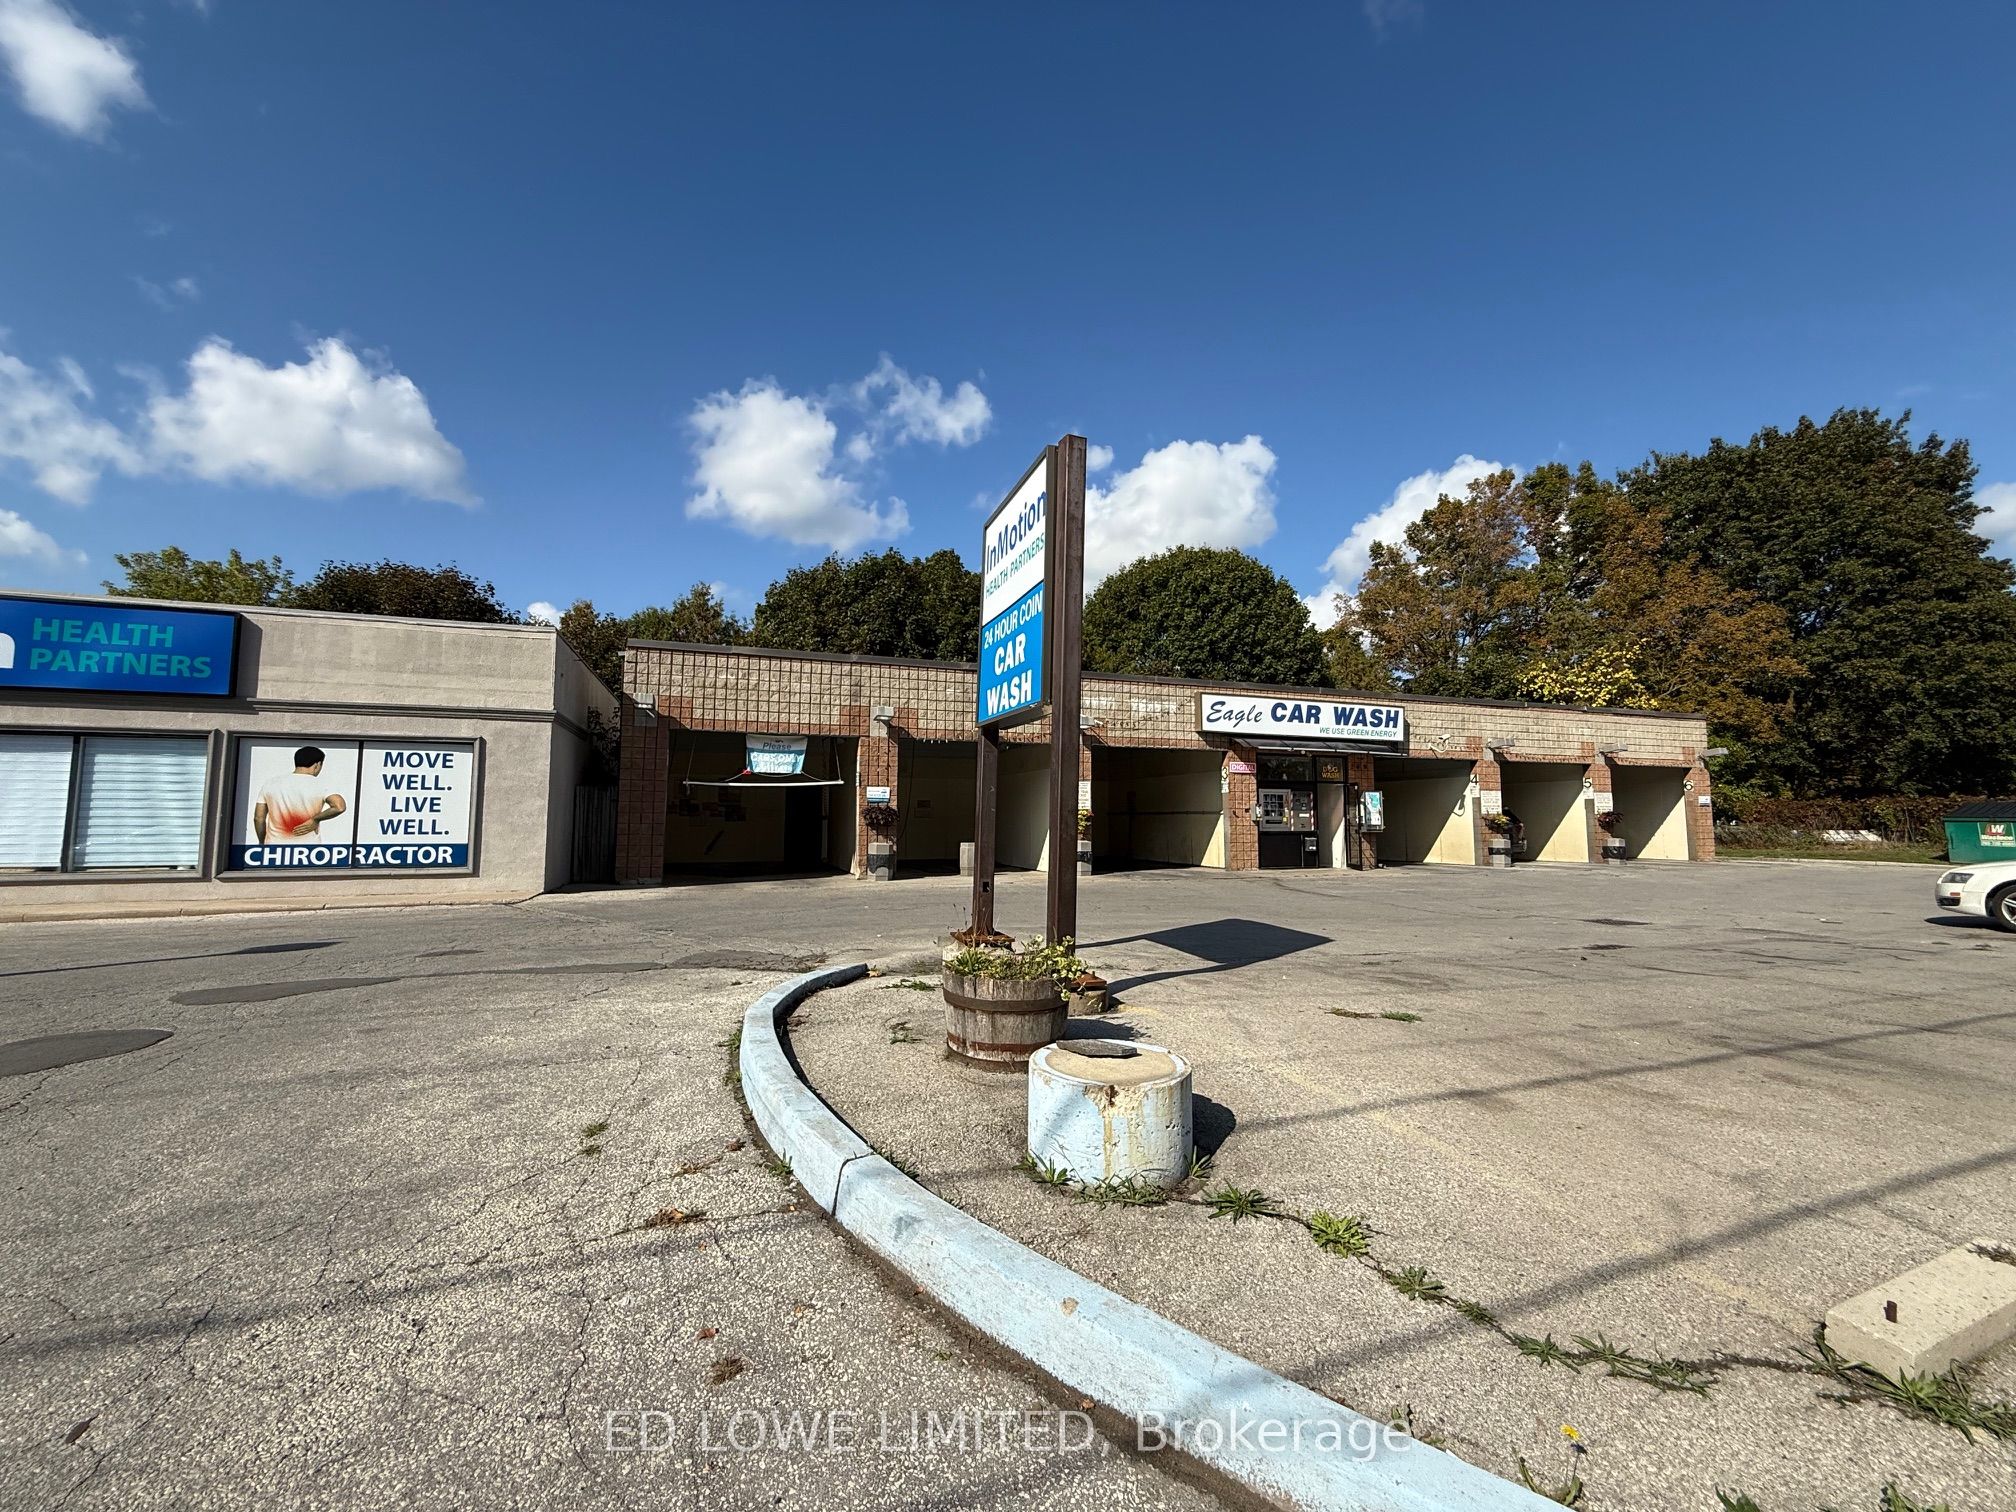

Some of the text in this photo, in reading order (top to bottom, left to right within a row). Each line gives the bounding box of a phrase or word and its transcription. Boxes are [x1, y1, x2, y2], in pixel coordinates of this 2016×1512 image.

[986, 491, 1047, 575] InMotion
[985, 532, 1045, 599] HEALTH PARTNERS
[984, 589, 1043, 650] 24 HOUR COIN
[33, 618, 174, 648] HEALTH
[994, 632, 1026, 676] CAR
[30, 648, 212, 679] PARTNERS
[986, 669, 1033, 717] WASH
[1206, 700, 1400, 729] Eagle CAR WASH
[1346, 728, 1370, 736] GREEN
[1370, 729, 1398, 738] ENERGY
[762, 742, 792, 751] Please
[383, 751, 454, 769] MOVE
[1222, 766, 1229, 779] 3
[1470, 773, 1478, 785] 4
[382, 773, 453, 791] WELL.
[1584, 777, 1592, 789] 5
[1684, 780, 1693, 791] 6
[390, 796, 442, 813] LIVE
[379, 818, 450, 835] WELL.
[244, 846, 453, 866] CHIROPRACTOR
